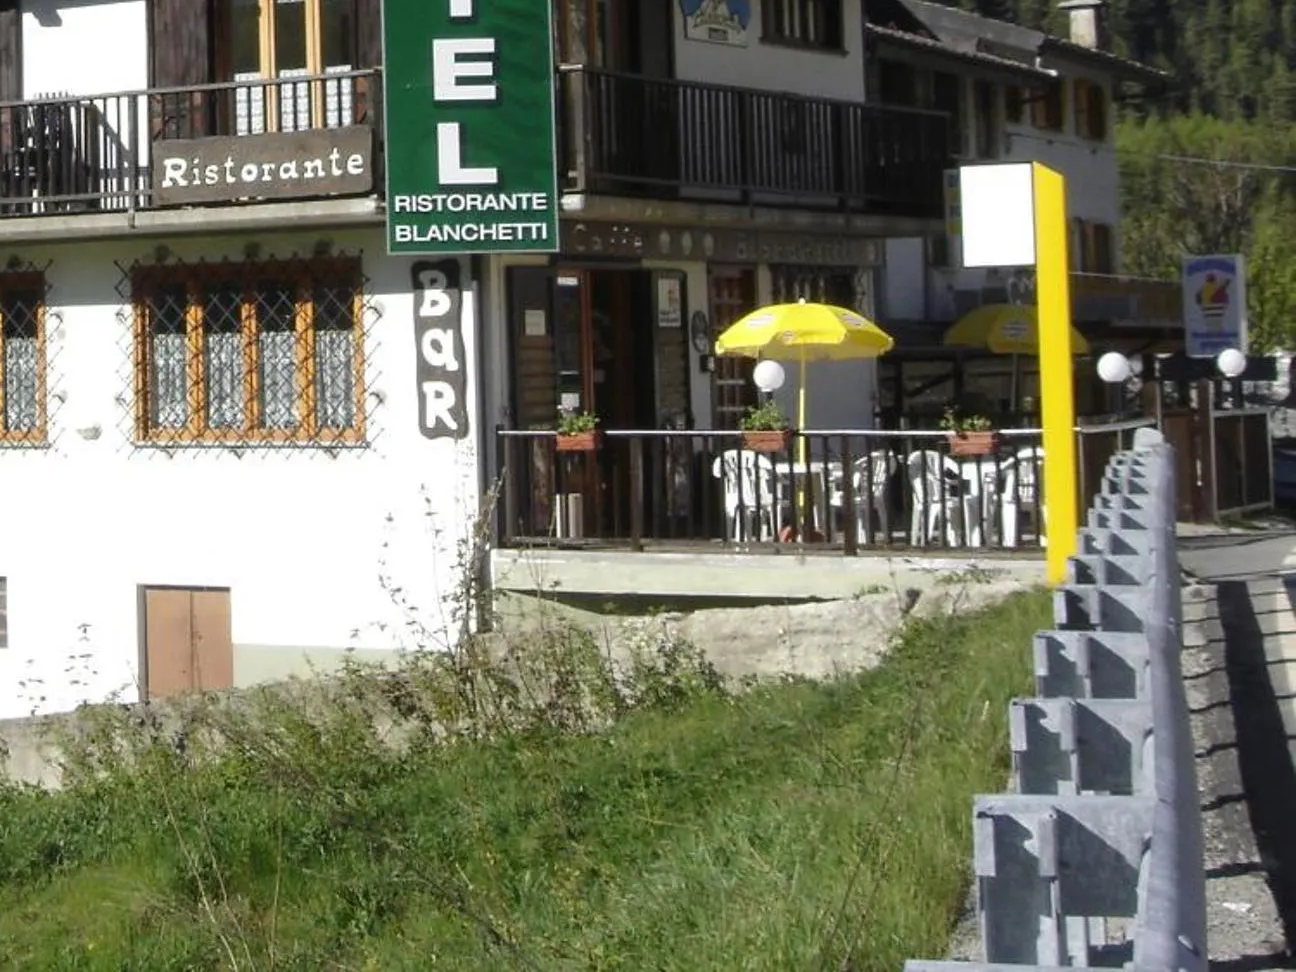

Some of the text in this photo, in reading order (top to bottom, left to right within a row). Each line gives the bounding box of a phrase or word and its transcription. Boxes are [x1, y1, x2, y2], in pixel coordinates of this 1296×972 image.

[161, 147, 365, 189] Ristorante
[394, 192, 548, 213] RISTORANTE
[394, 222, 548, 242] BLANCHETTI
